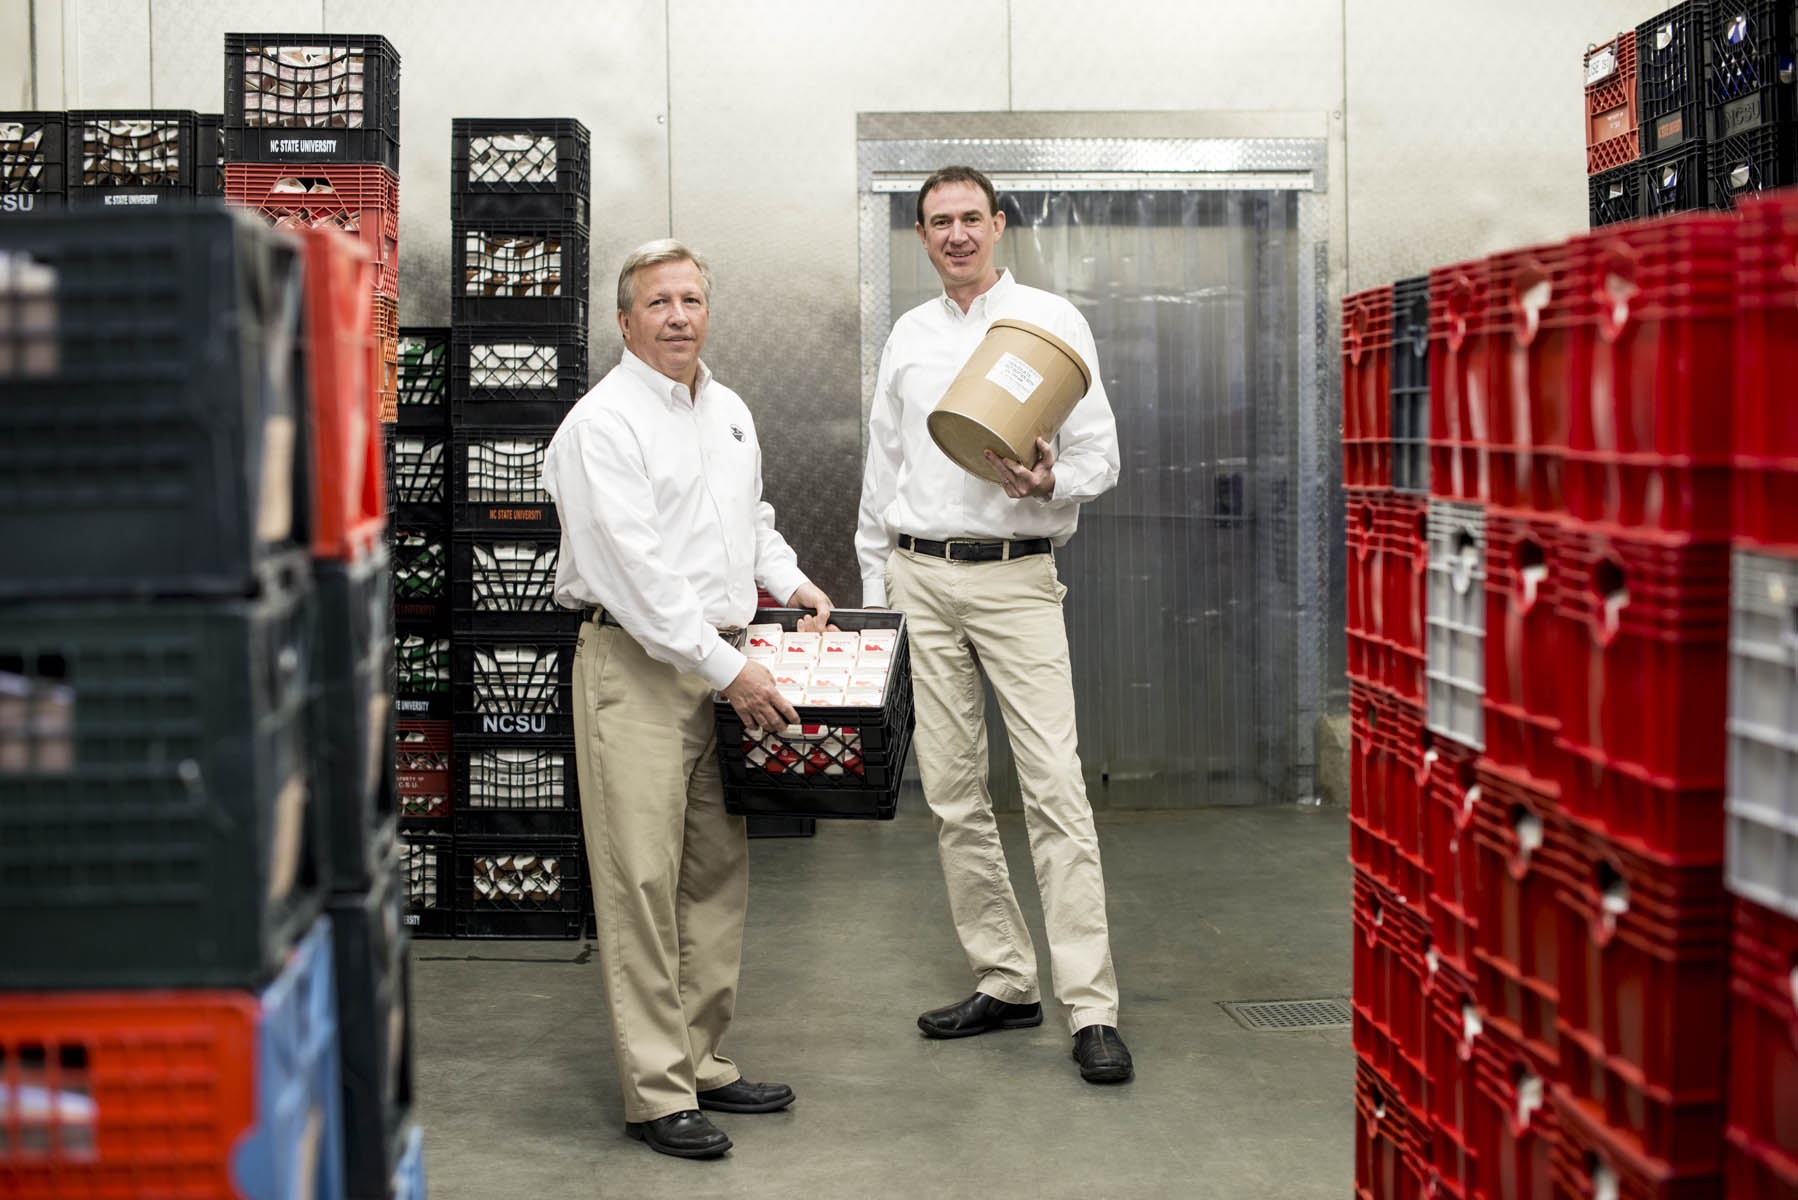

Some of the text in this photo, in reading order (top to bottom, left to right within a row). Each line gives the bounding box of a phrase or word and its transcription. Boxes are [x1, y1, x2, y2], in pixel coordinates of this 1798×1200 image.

[270, 140, 337, 152] NC STATE UNIVERSITY
[0, 194, 33, 211] SU
[113, 195, 128, 205] STATE
[129, 195, 158, 205] UNIVERSITY
[498, 509, 512, 520] STATE
[513, 509, 543, 520] UNIVERSITY
[401, 700, 429, 711] UNIVERSITY
[483, 715, 546, 732] NCSU
